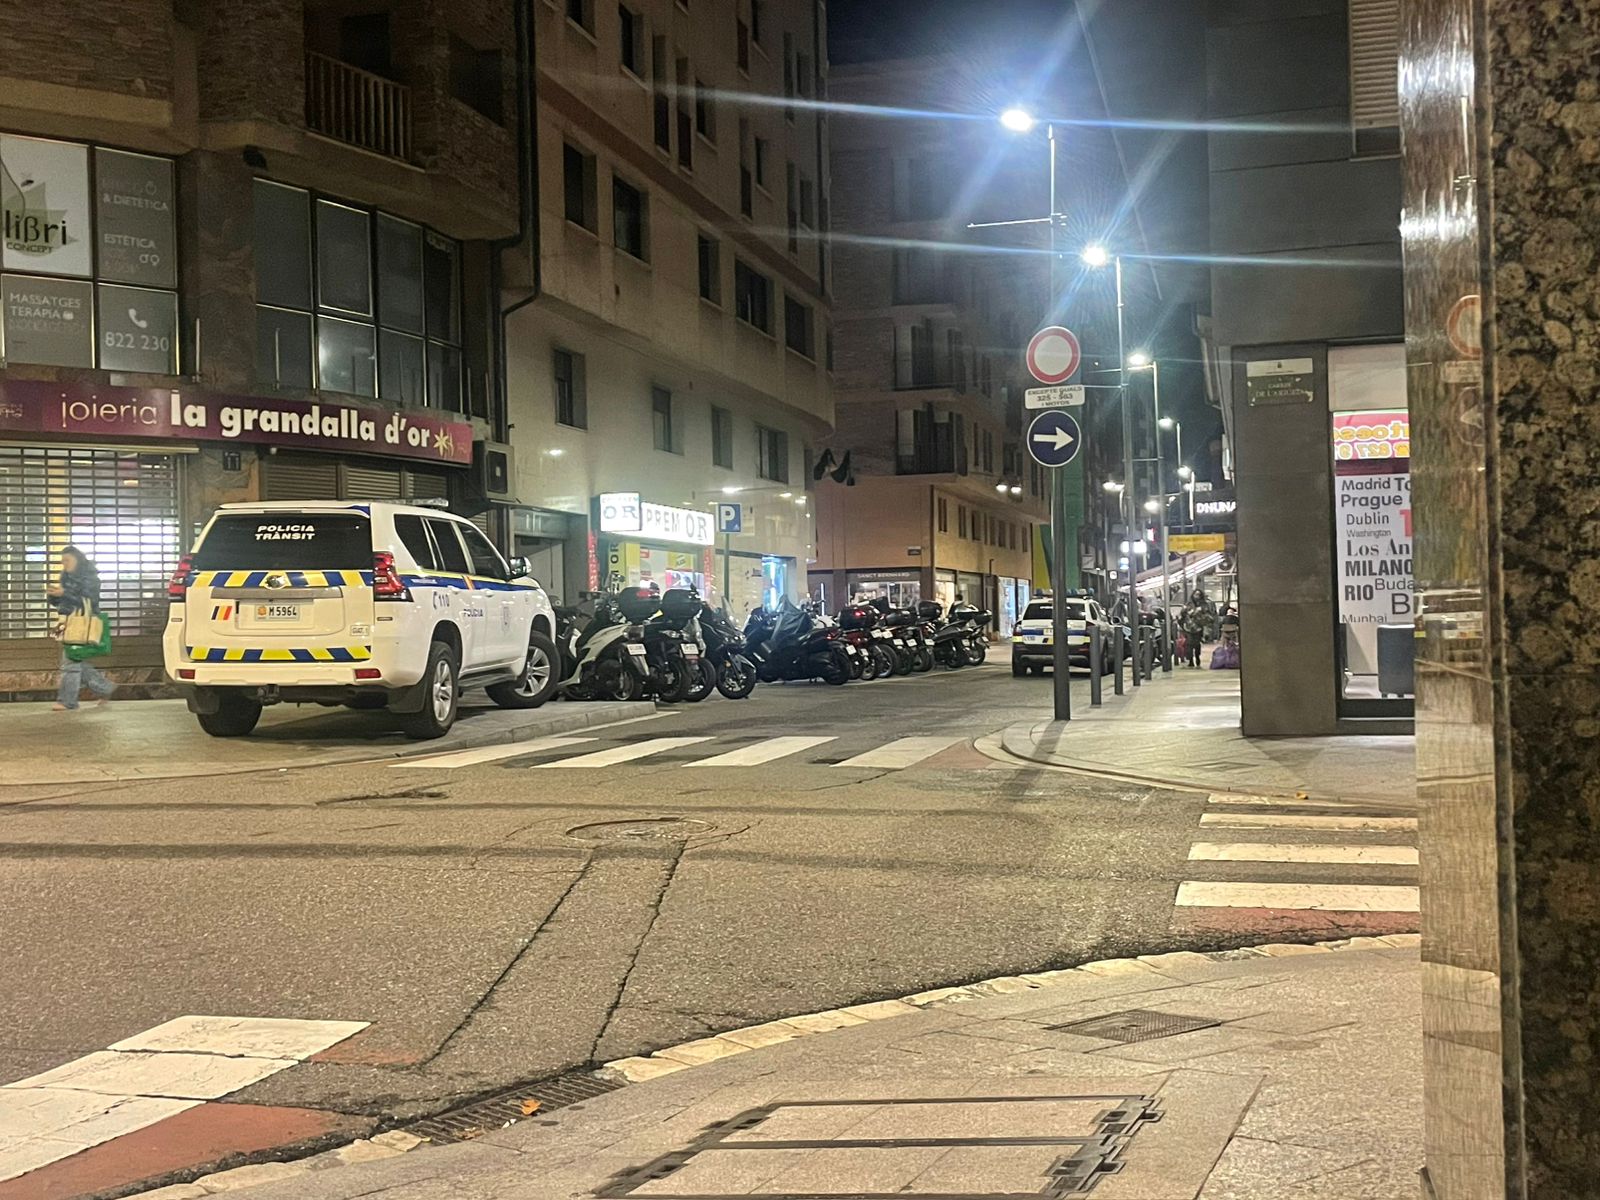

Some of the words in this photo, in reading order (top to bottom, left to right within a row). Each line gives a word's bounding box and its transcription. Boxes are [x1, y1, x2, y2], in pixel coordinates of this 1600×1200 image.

[6, 241, 53, 253] CONCEPT
[9, 292, 81, 308] MASSATGES
[105, 331, 135, 349] 822
[140, 334, 169, 352] 230
[61, 393, 158, 428] joieria
[170, 389, 206, 428] la
[220, 405, 376, 442] grandalla
[384, 411, 431, 448] d'or
[1341, 477, 1391, 491] Madrid
[1341, 494, 1403, 510] Prague
[720, 505, 735, 530] P
[1346, 511, 1389, 526] Dublin
[1346, 528, 1391, 541] Washington
[1346, 540, 1379, 557] Los
[1386, 538, 1410, 556] An
[1345, 559, 1413, 577] MILANO
[1344, 584, 1374, 601] RIO
[1375, 577, 1415, 591] Buda
[1391, 592, 1411, 615] B
